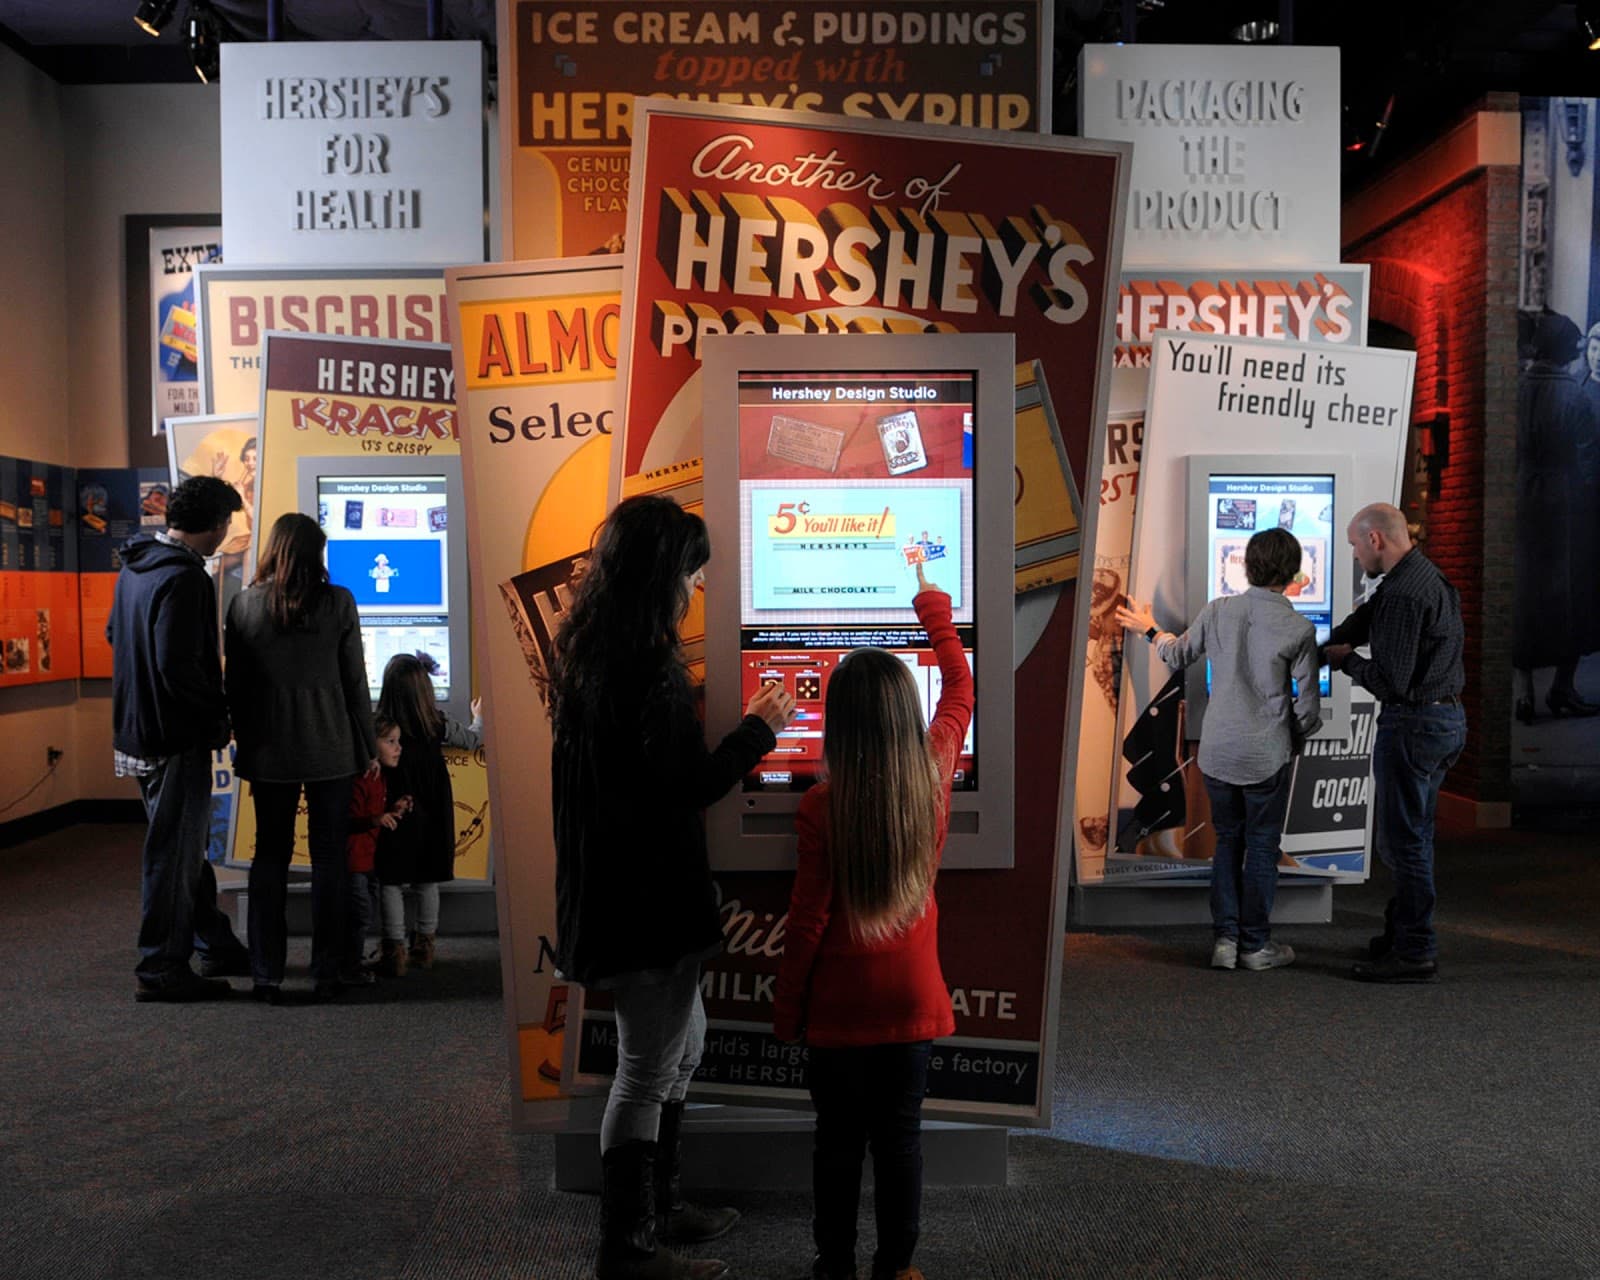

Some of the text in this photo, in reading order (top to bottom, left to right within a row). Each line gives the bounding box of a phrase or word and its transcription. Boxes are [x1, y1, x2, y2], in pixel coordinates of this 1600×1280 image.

[532, 11, 1027, 46] ICE CREAM & PUDDINGS
[654, 49, 907, 87] topped with
[260, 76, 451, 120] HERSHEY'S
[1117, 80, 1304, 122] PACKAGING
[321, 133, 390, 175] FOR
[1180, 136, 1246, 178] THE
[692, 134, 962, 219] Another of
[291, 189, 421, 231] HEALTH
[1134, 190, 1287, 231] PRODUCT
[658, 192, 1095, 325] HERSHEY'S
[1116, 278, 1352, 343] HERSHEY'S
[1168, 340, 1346, 386] You'll need its
[772, 386, 937, 402] Hershey Design Studio
[1218, 382, 1398, 429] friendly cheer
[488, 402, 614, 443] Selec
[387, 442, 432, 456] CRISPY
[646, 458, 703, 480] HERSHE
[337, 484, 428, 493] Hershey Design Studio
[1226, 484, 1314, 493] Hershey Design Studio
[804, 517, 839, 533] You'll
[840, 517, 865, 533] like
[792, 586, 878, 594] MILK CHOCOLATE
[1312, 776, 1369, 809] COCOA
[952, 1050, 1028, 1085] factory
